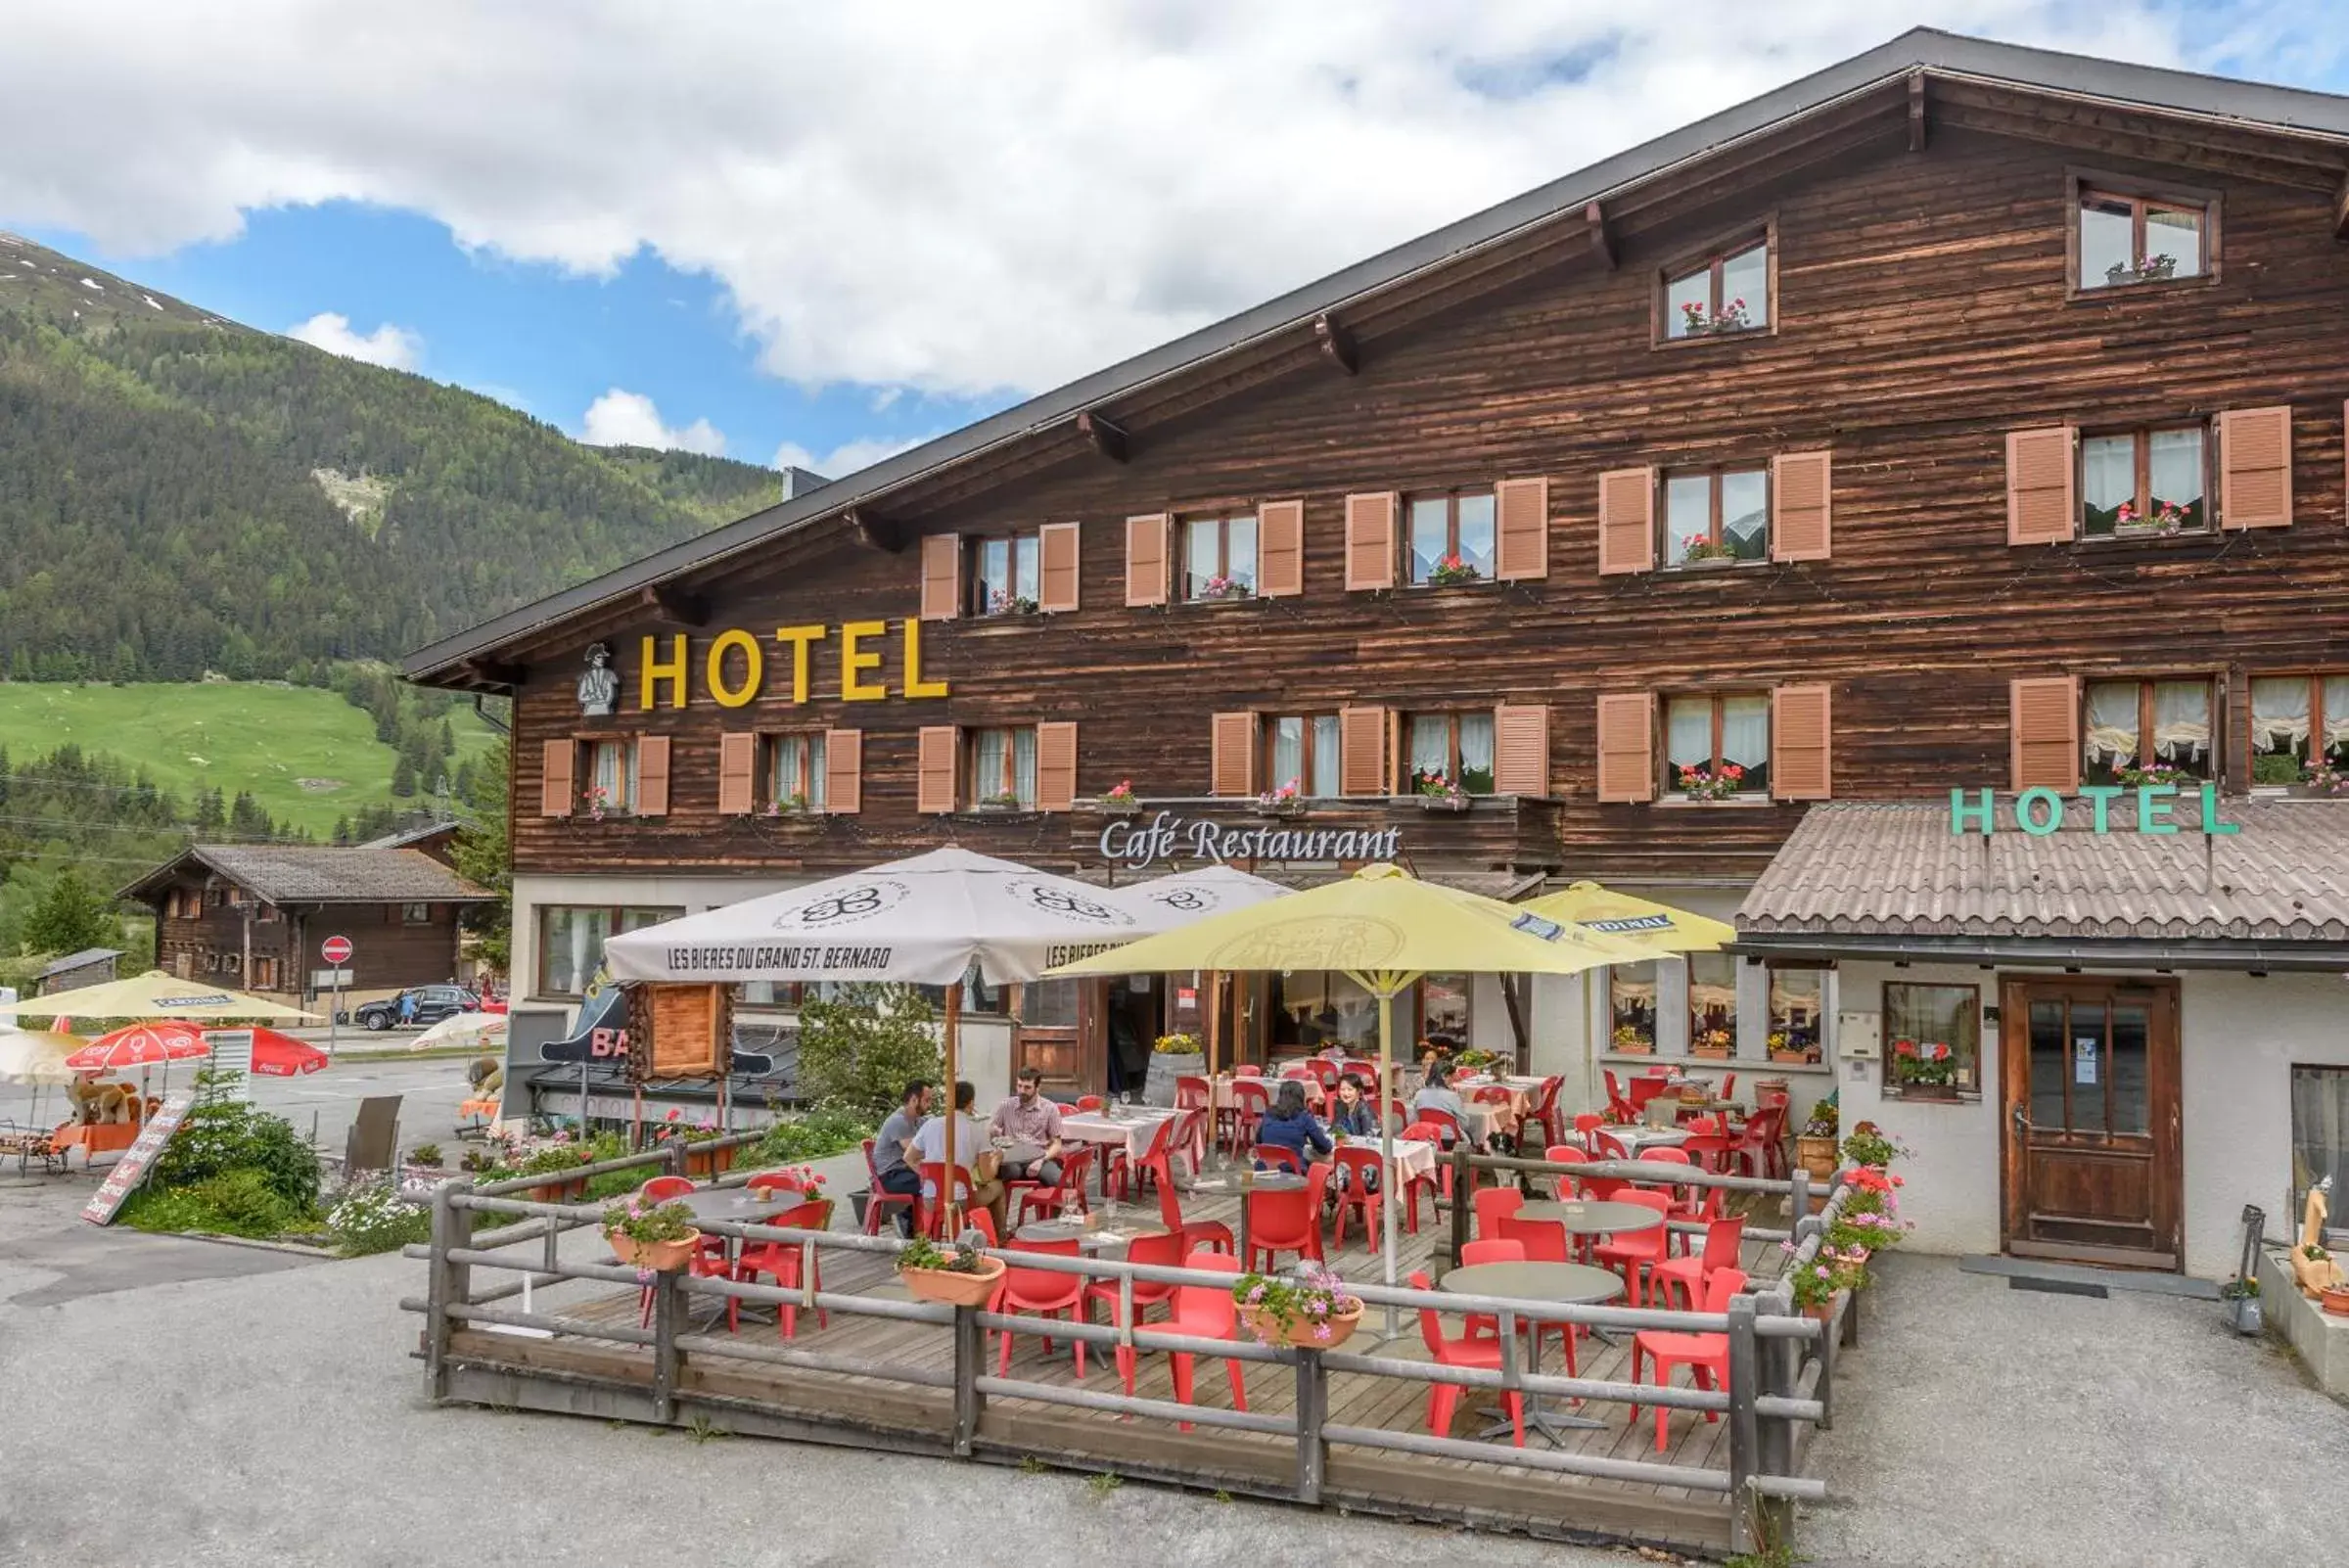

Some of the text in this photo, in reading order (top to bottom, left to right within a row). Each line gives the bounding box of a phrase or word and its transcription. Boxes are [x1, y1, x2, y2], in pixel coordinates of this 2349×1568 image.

[641, 618, 948, 711] HOTEL
[1951, 783, 2240, 835] HOTEL
[1100, 810, 1403, 870] Café Restaurant
[668, 946, 892, 971] LES BIERES DU GRAND ST. BERNARD
[1045, 945, 1067, 969] LES
[591, 1027, 629, 1058] BA
